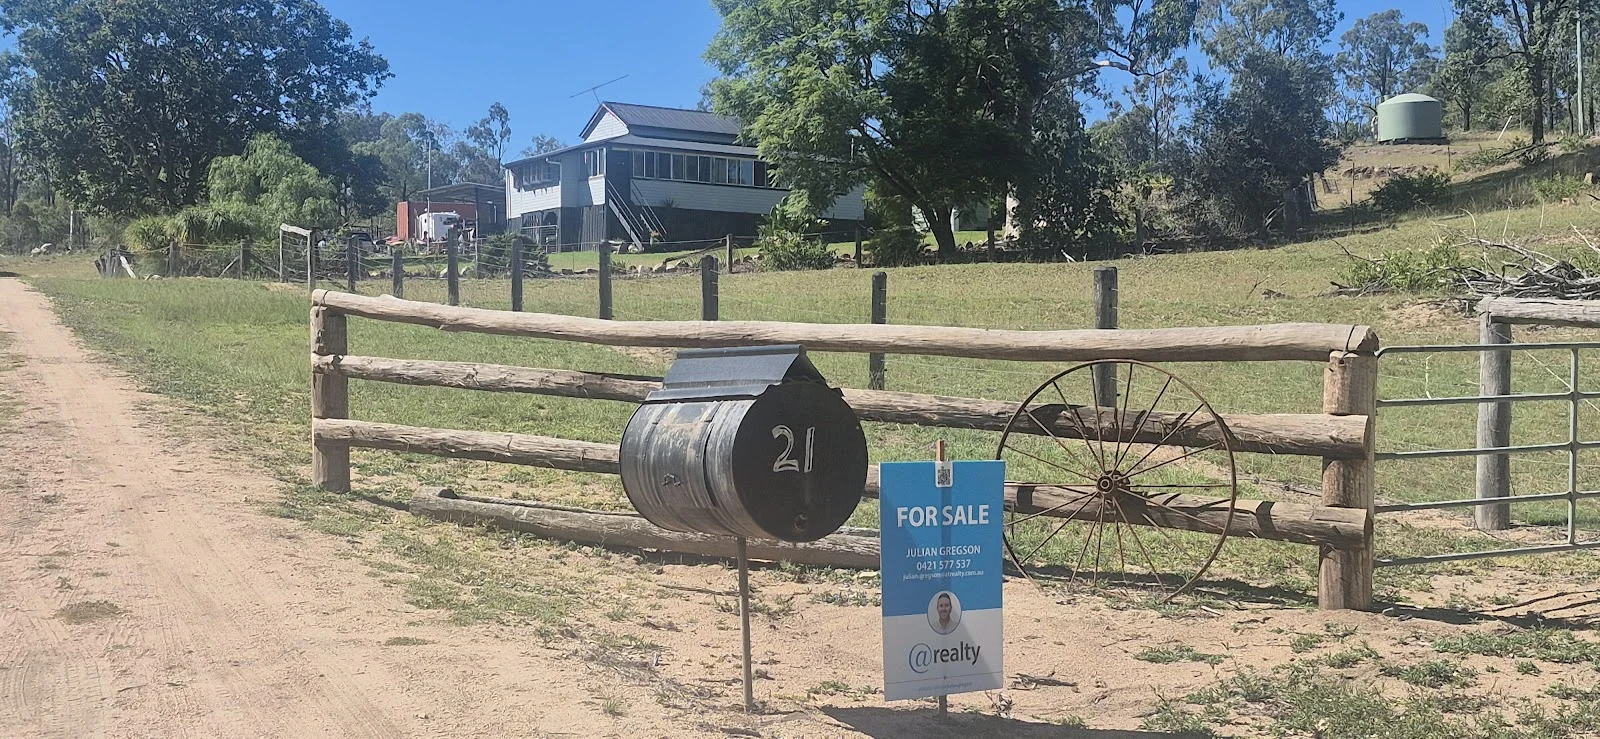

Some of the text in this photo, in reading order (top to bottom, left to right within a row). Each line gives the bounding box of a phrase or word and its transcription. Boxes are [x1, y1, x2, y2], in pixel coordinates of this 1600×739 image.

[771, 424, 816, 473] 21
[897, 505, 989, 527] FOR SALE
[906, 545, 981, 558] JULIAN GREGSON
[916, 559, 971, 571] 0421 577 537
[908, 641, 981, 674] @realty
